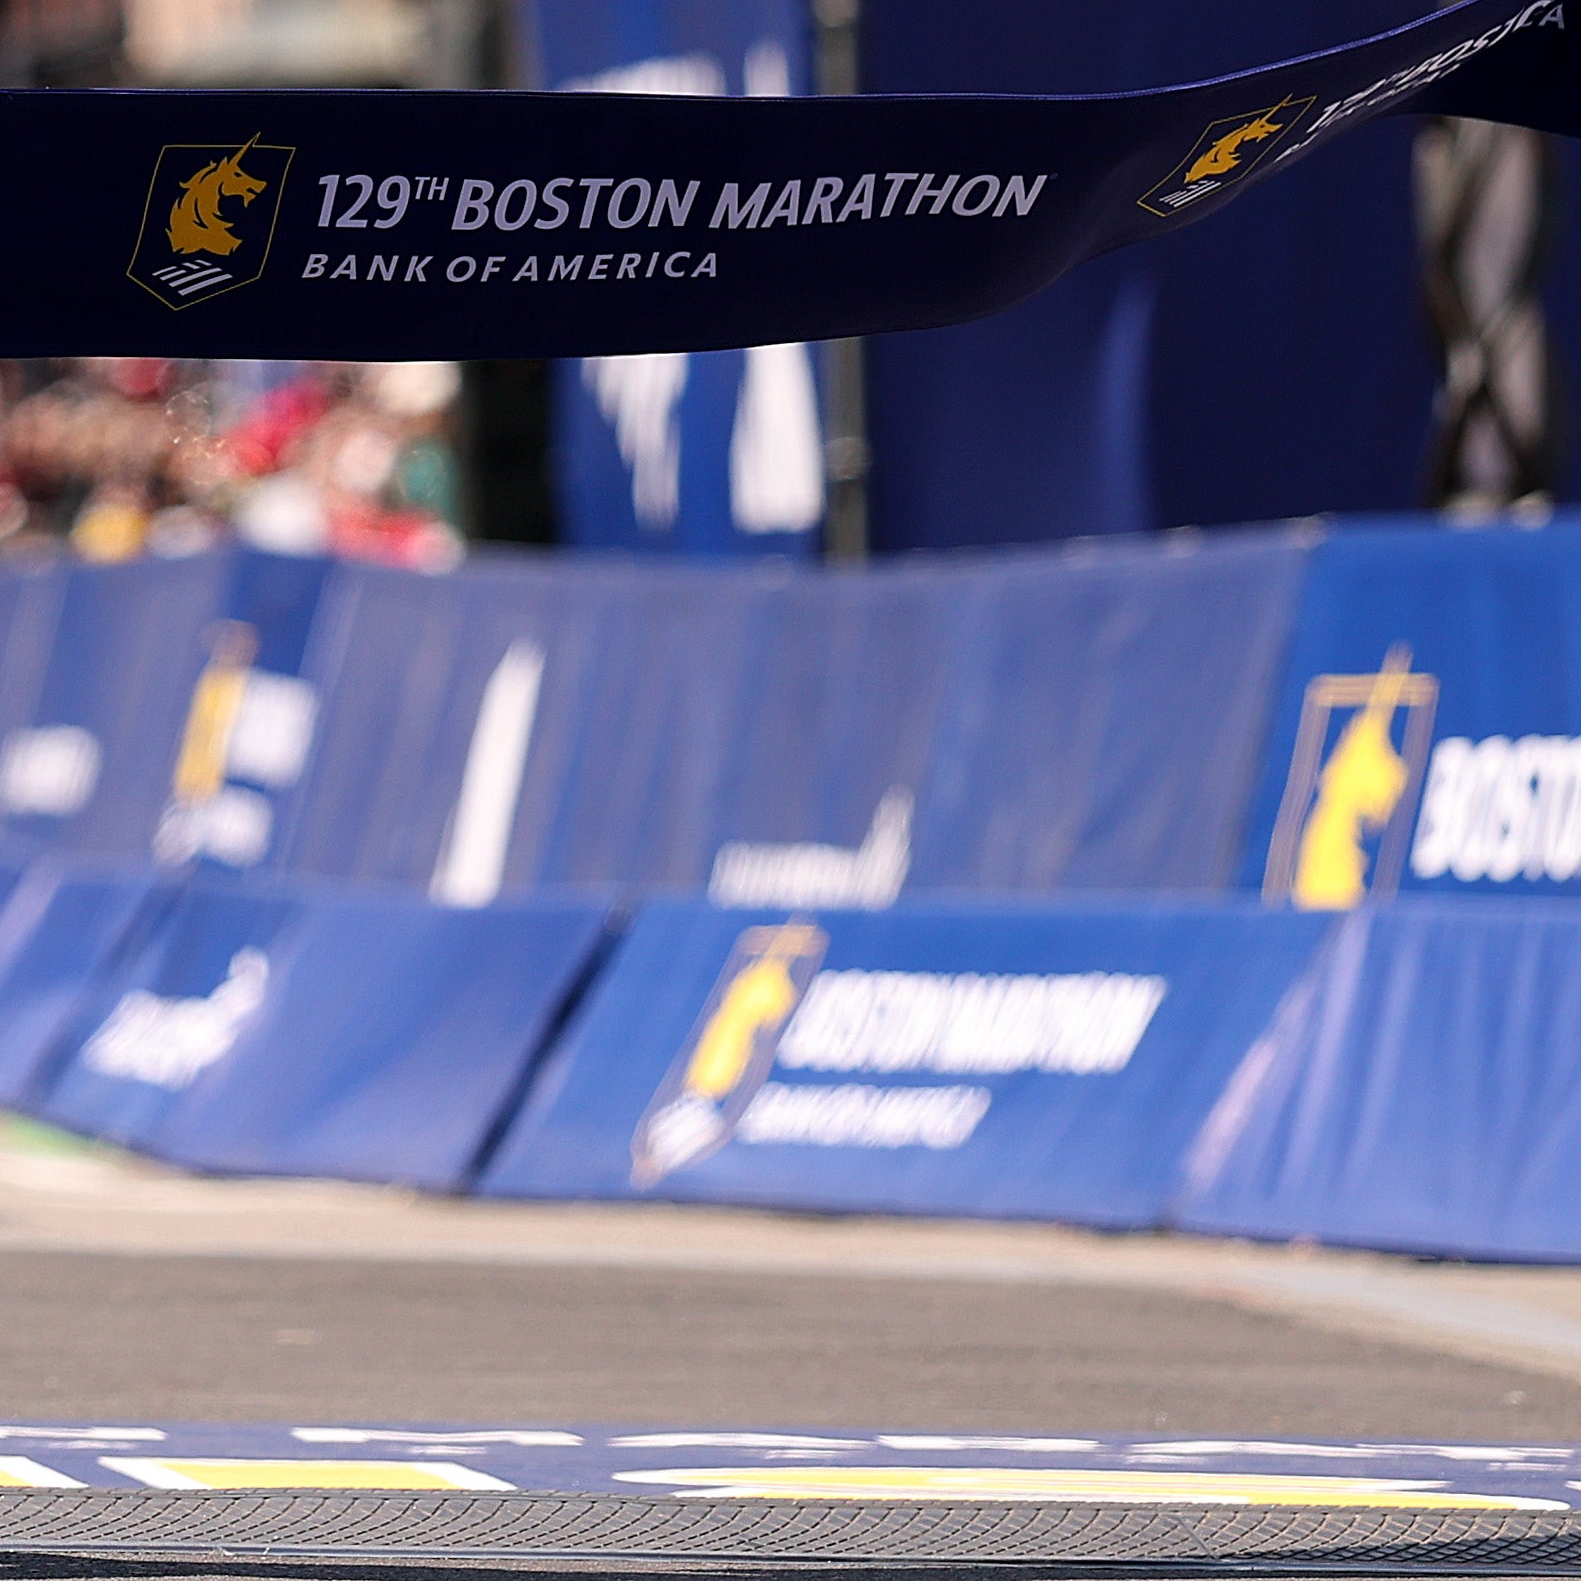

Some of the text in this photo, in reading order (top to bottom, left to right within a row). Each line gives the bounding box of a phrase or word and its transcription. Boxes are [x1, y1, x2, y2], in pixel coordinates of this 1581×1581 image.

[317, 172, 1048, 231] 129TH BOSTON MARATHON
[301, 251, 717, 283] BANK OF AMERICA
